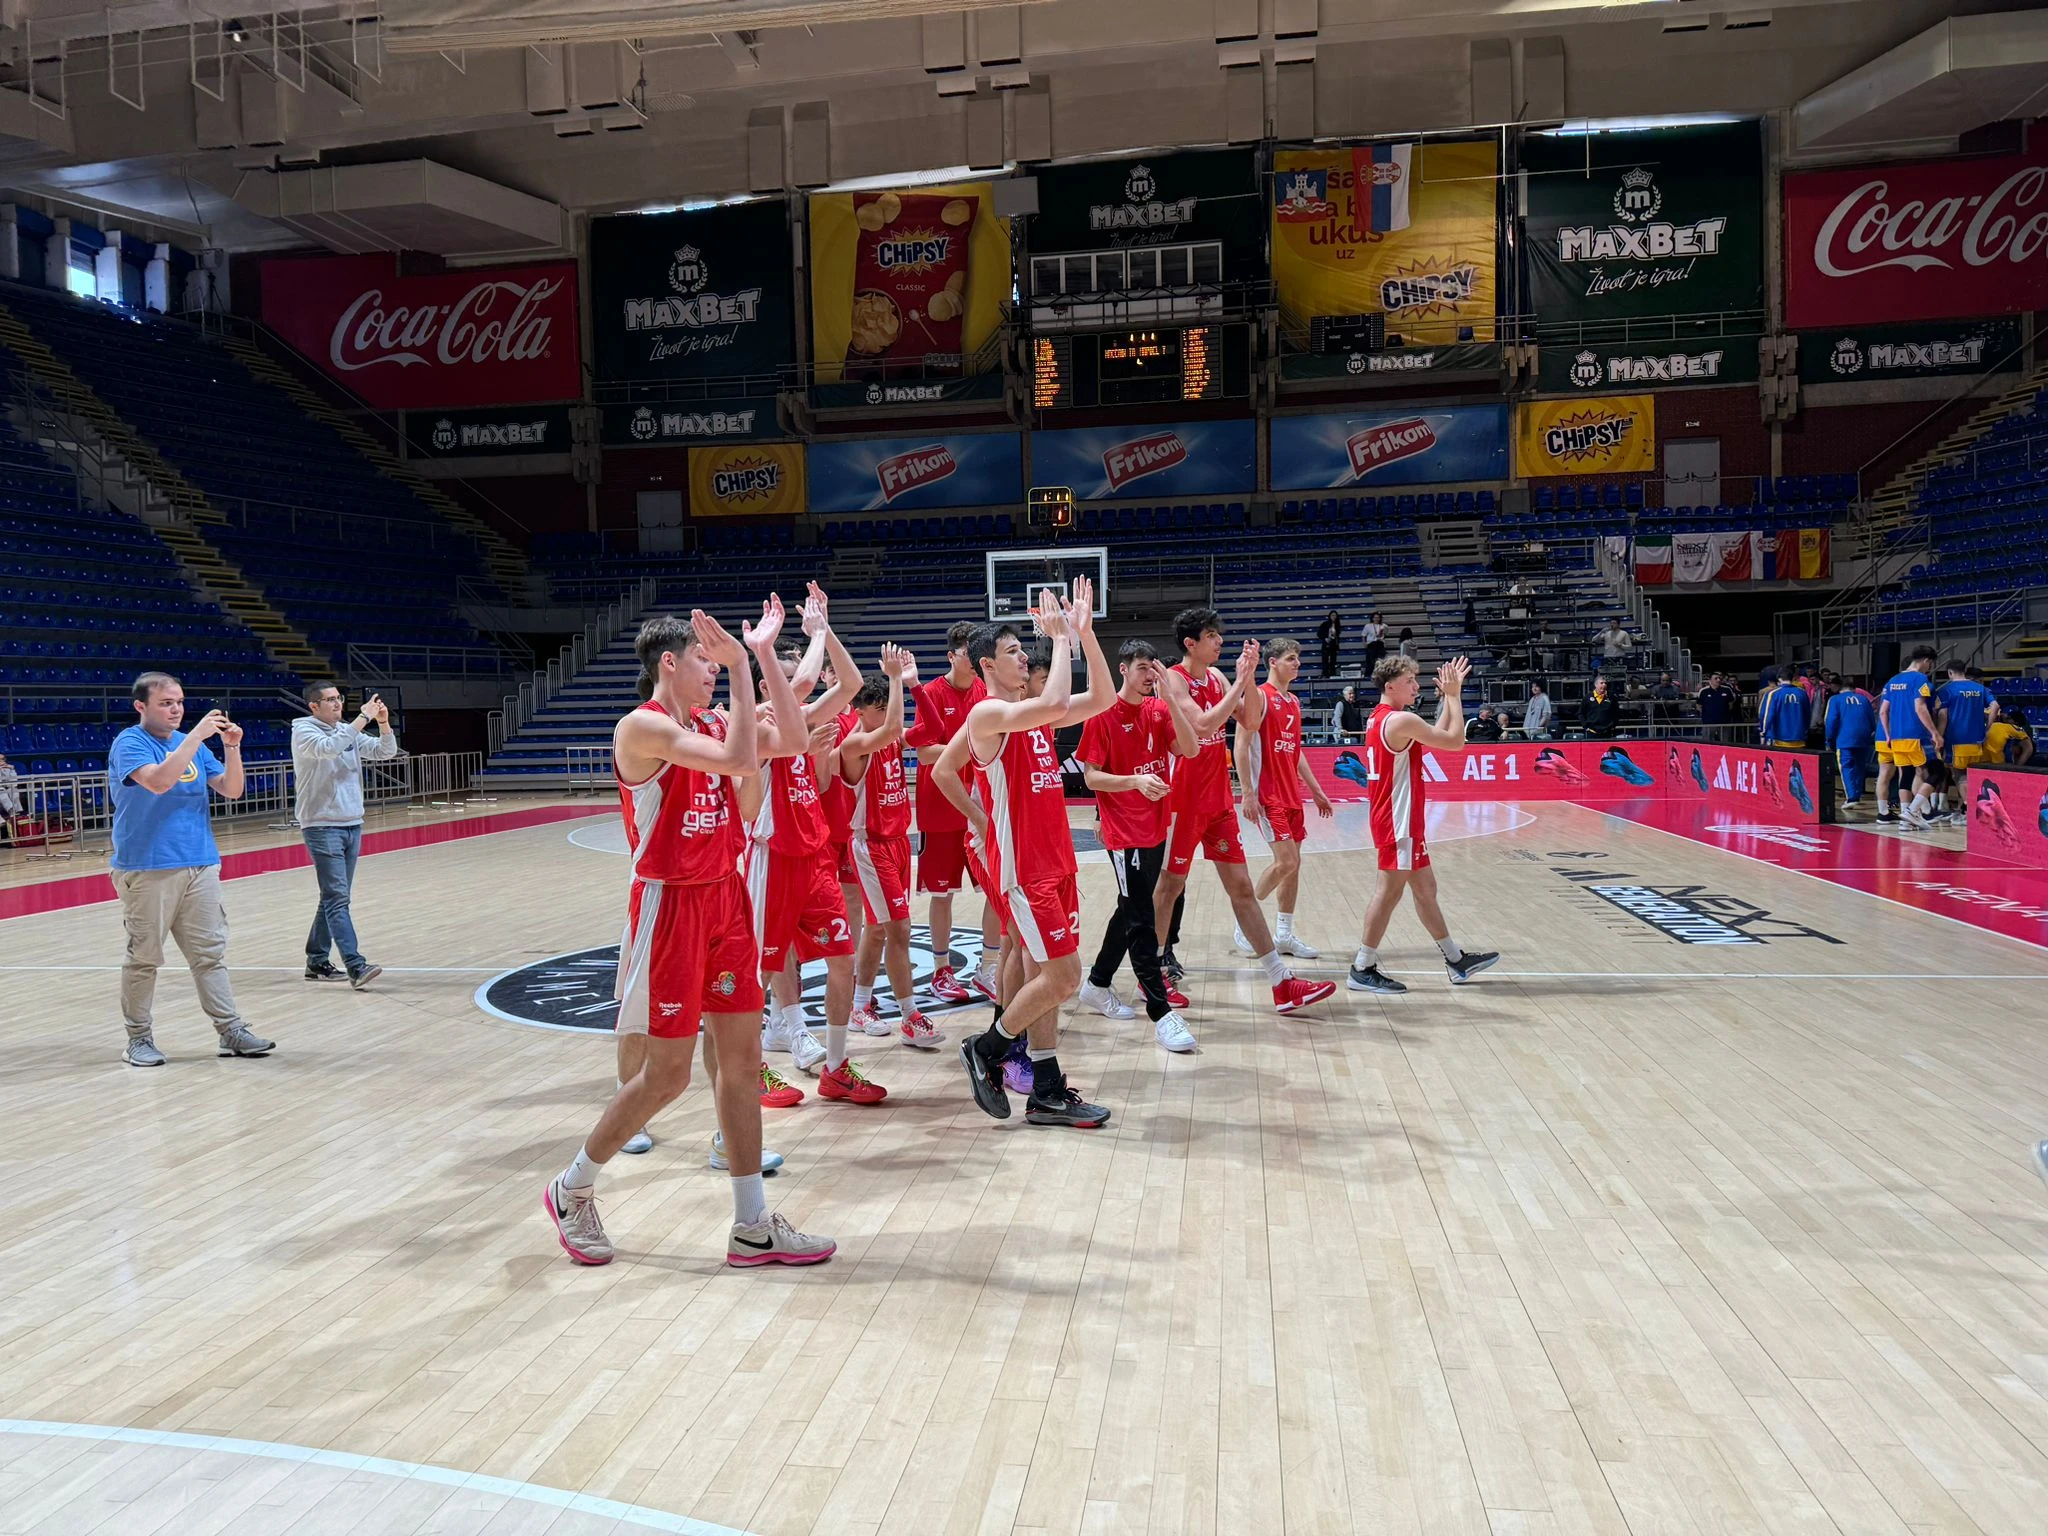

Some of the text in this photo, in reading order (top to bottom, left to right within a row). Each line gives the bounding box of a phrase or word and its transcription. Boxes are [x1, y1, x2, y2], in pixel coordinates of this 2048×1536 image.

[1090, 196, 1198, 231] MAXBET
[1814, 166, 2048, 278] Coca-Co
[1336, 248, 1356, 260] uz
[1557, 217, 1727, 263] MAXBET
[896, 283, 927, 293] CLASSIC
[329, 276, 566, 371] Coca-Cola
[624, 287, 762, 331] MAXBET
[1368, 353, 1433, 371] MAXBET
[1607, 350, 1724, 382] MAXBET
[1869, 337, 1986, 369] MAXBET
[885, 384, 944, 402] MAXBET
[461, 420, 548, 446] MAXBET
[662, 409, 757, 437] MAXBET
[1108, 434, 1186, 480] Frikom
[1351, 420, 1433, 467] Frikom
[881, 449, 955, 490] Frikom
[1285, 714, 1295, 730] 7
[883, 757, 902, 780] 13
[1463, 755, 1520, 781] AE 1
[1736, 760, 1758, 794] AE 1
[1131, 848, 1141, 871] 4
[1588, 885, 1763, 945] GENERATION
